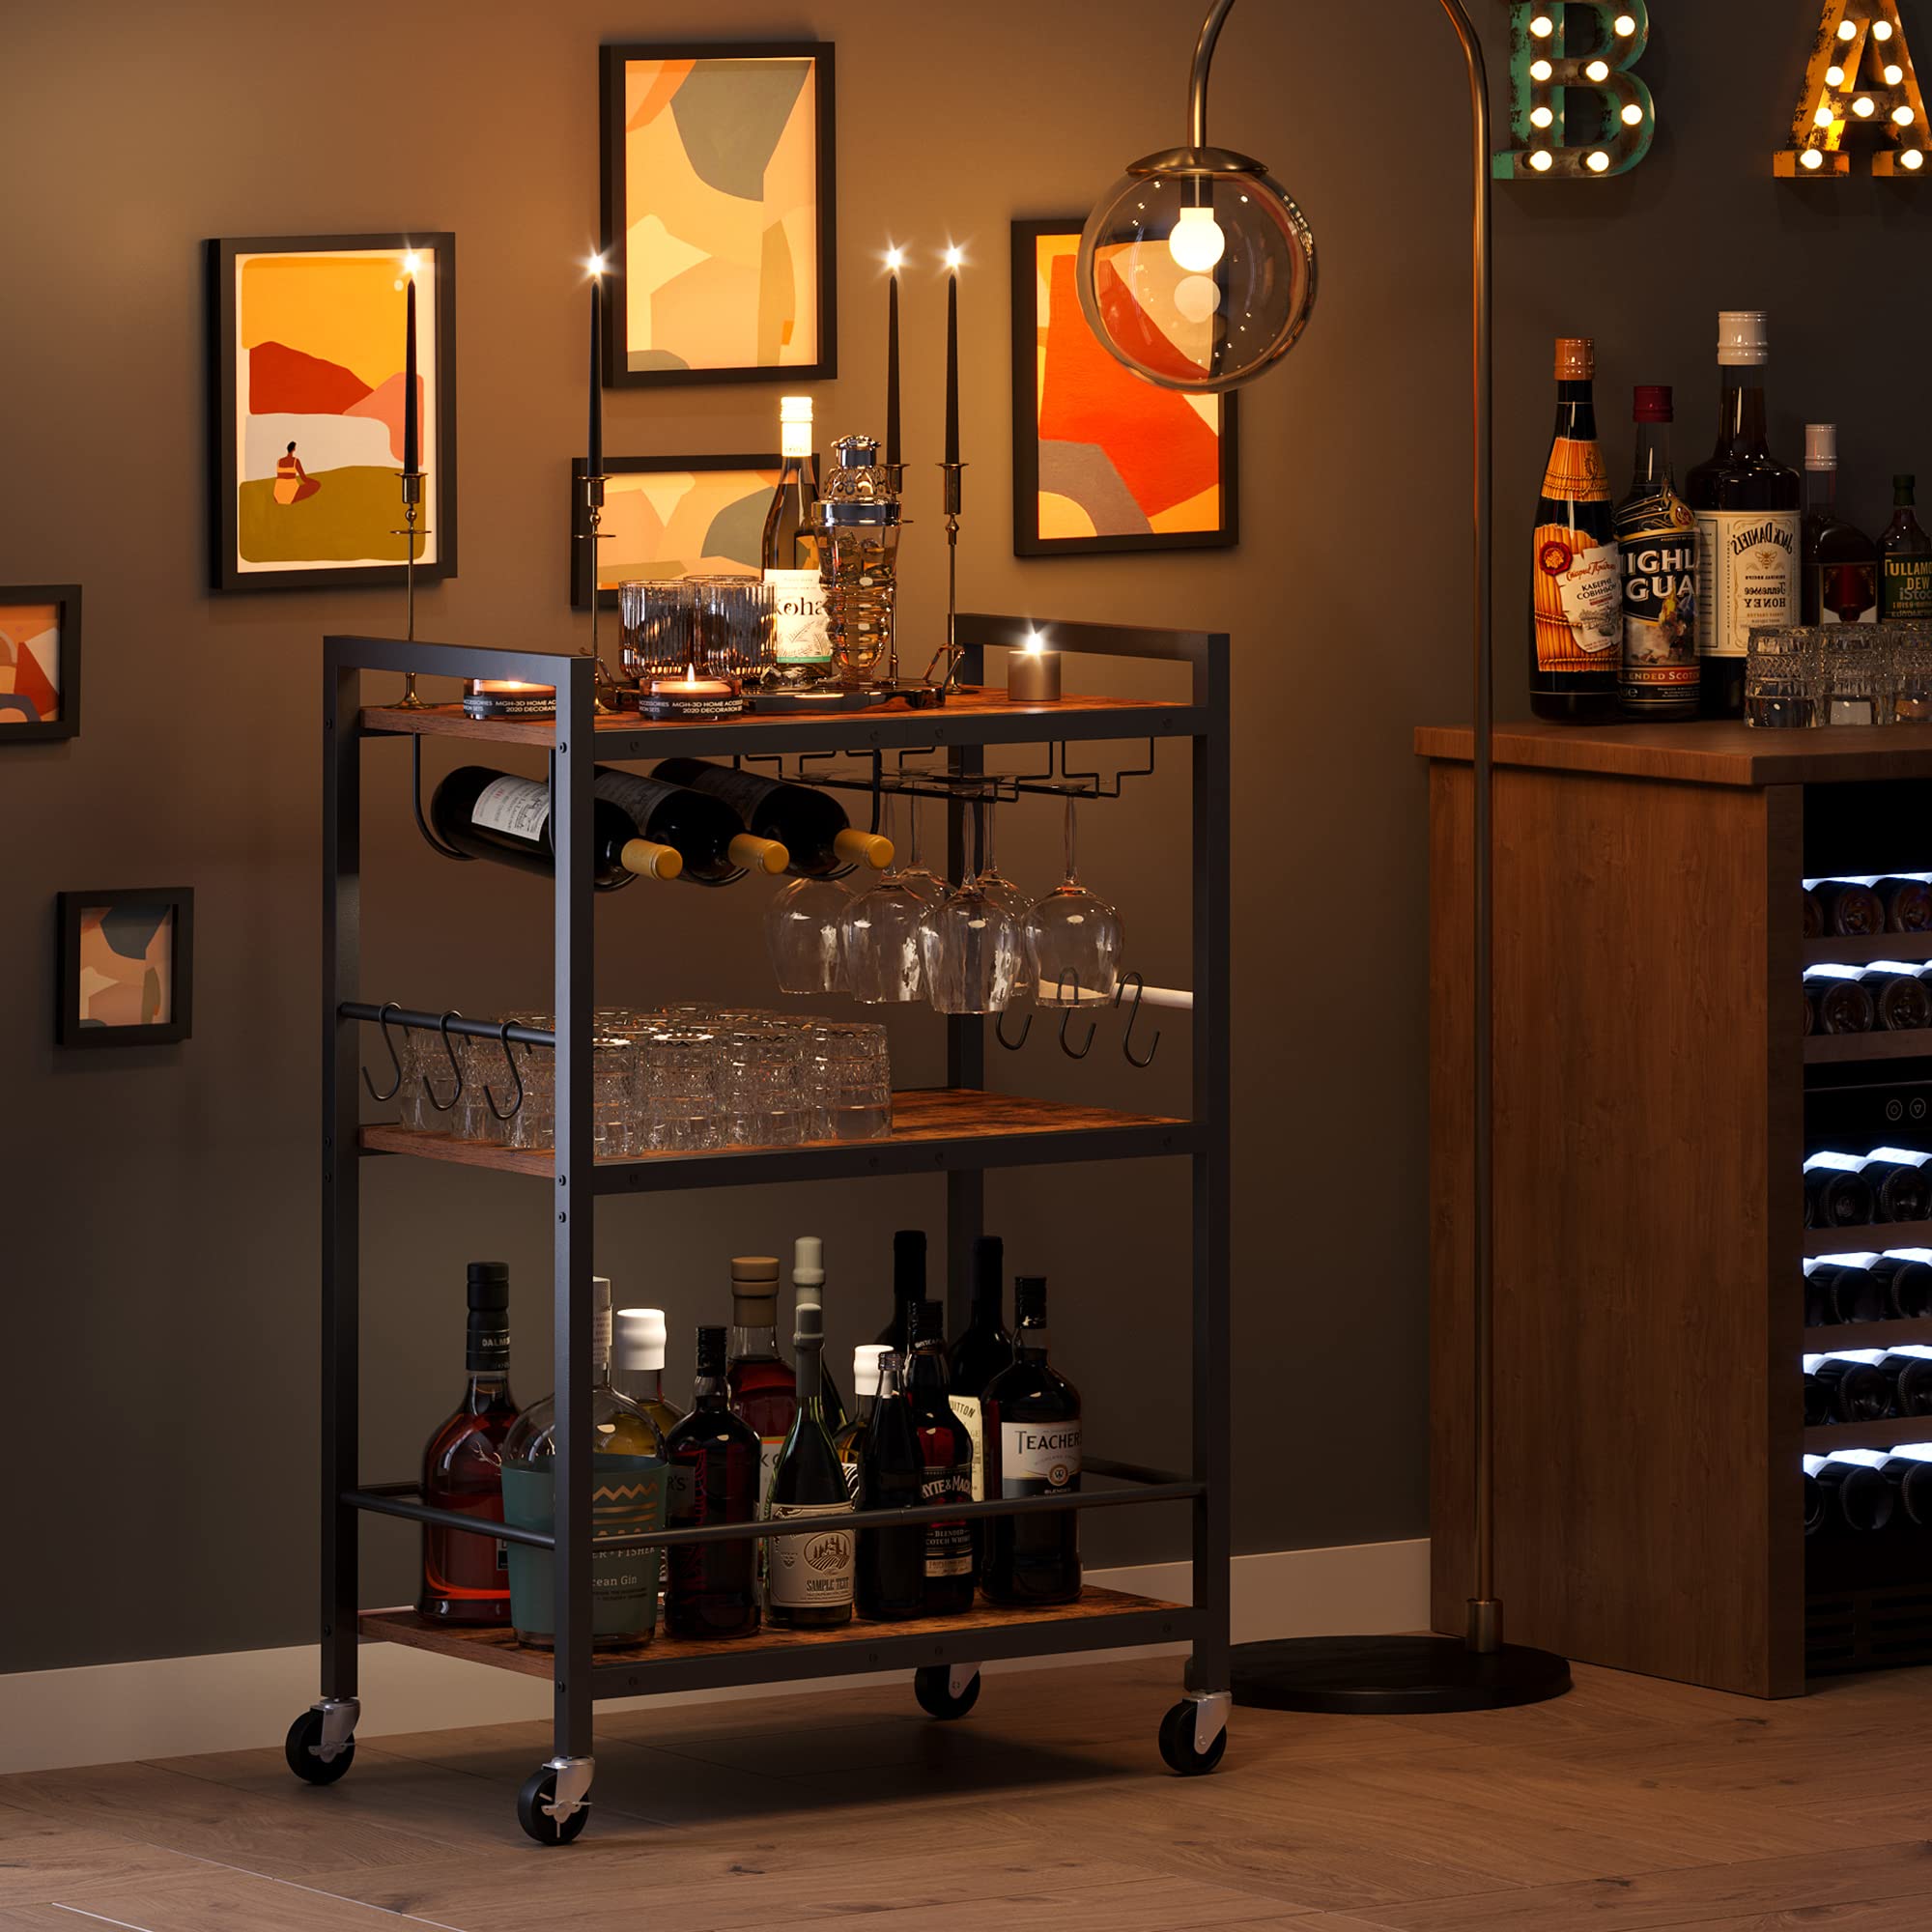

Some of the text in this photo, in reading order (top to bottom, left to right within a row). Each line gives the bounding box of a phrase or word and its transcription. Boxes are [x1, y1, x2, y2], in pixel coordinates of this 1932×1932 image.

[1906, 577, 1930, 590] DEW
[617, 1547, 655, 1558] FISHER
[620, 1575, 638, 1586] Gin
[807, 1576, 850, 1592] SAMPLE TEXT
